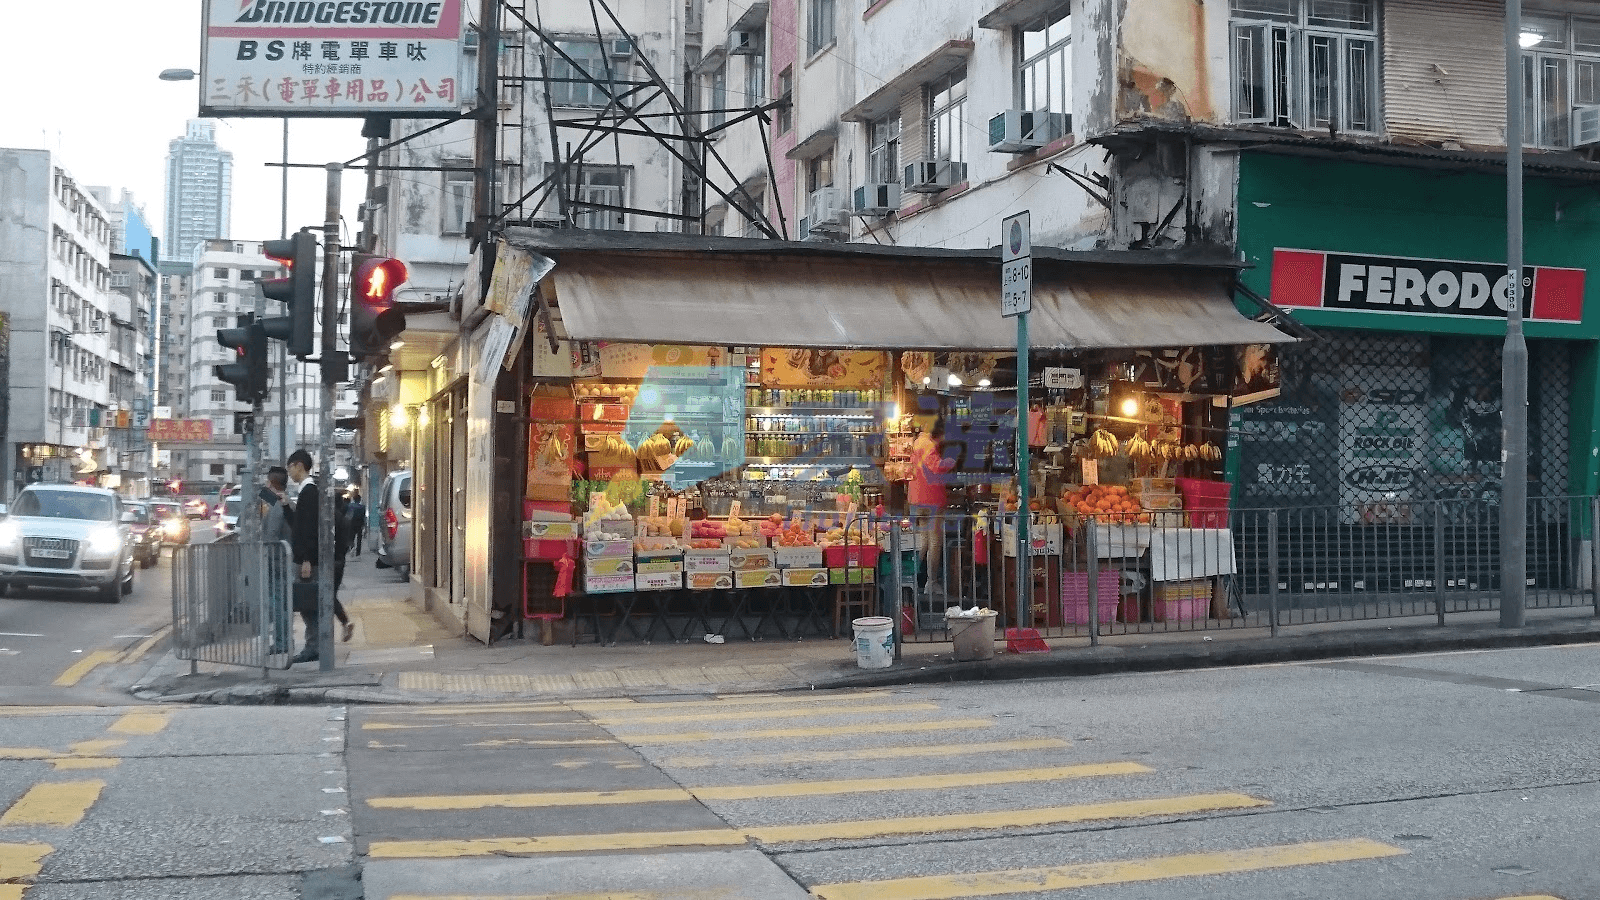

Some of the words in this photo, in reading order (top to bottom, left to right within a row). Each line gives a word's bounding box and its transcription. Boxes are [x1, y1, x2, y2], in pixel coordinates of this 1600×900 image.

[234, 1, 441, 24] BRIDGESTONE
[302, 63, 362, 75] 特約經銷商
[1354, 437, 1389, 449] ROCK
